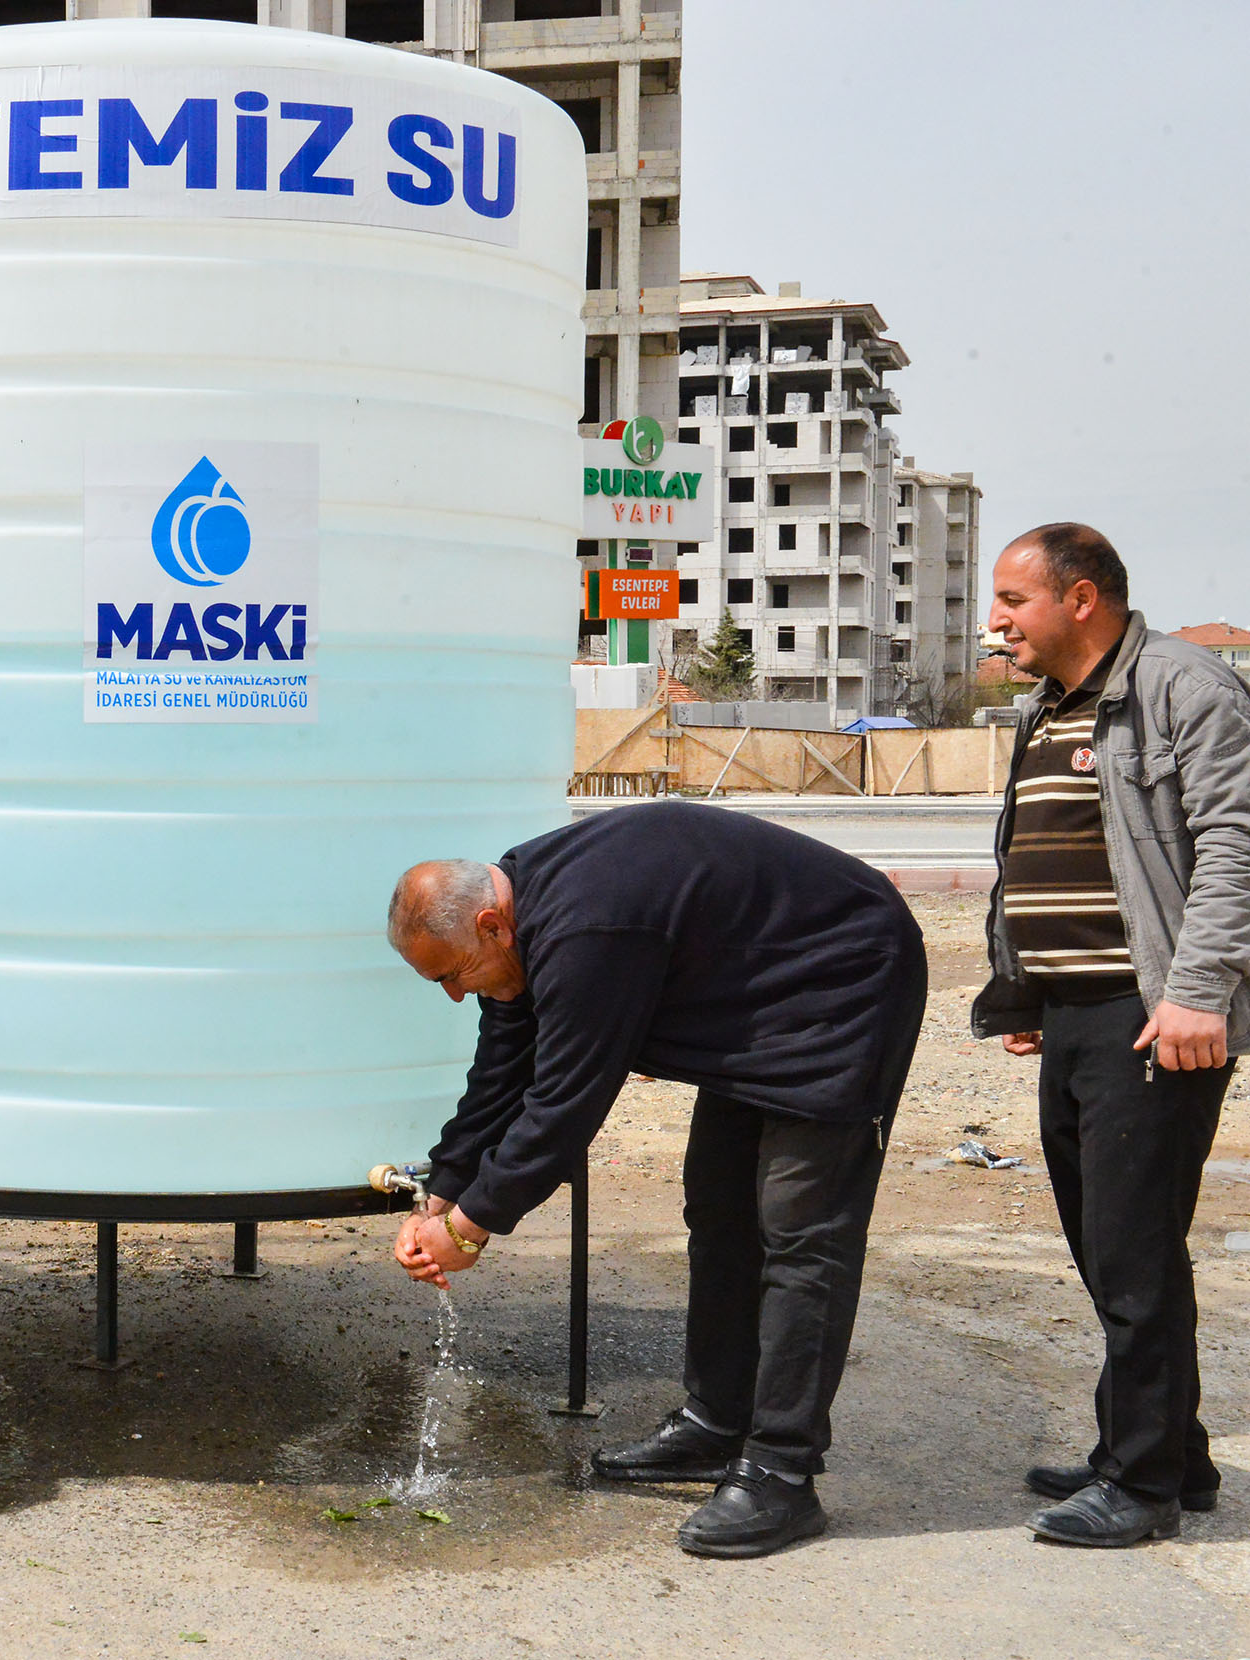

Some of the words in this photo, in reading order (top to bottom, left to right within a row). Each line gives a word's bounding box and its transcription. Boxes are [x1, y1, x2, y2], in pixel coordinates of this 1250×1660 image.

[387, 113, 516, 219] SU
[584, 466, 703, 500] BURKAY
[612, 502, 675, 525] YAPI
[612, 578, 670, 593] ESENTEPE
[621, 593, 661, 610] EVLERİ
[96, 671, 161, 686] MALATYA
[163, 673, 183, 686] SU
[96, 690, 157, 708] İDARESİ
[162, 692, 212, 708] GENEL
[216, 690, 308, 709] MÜDÜRLÜĞÜ
